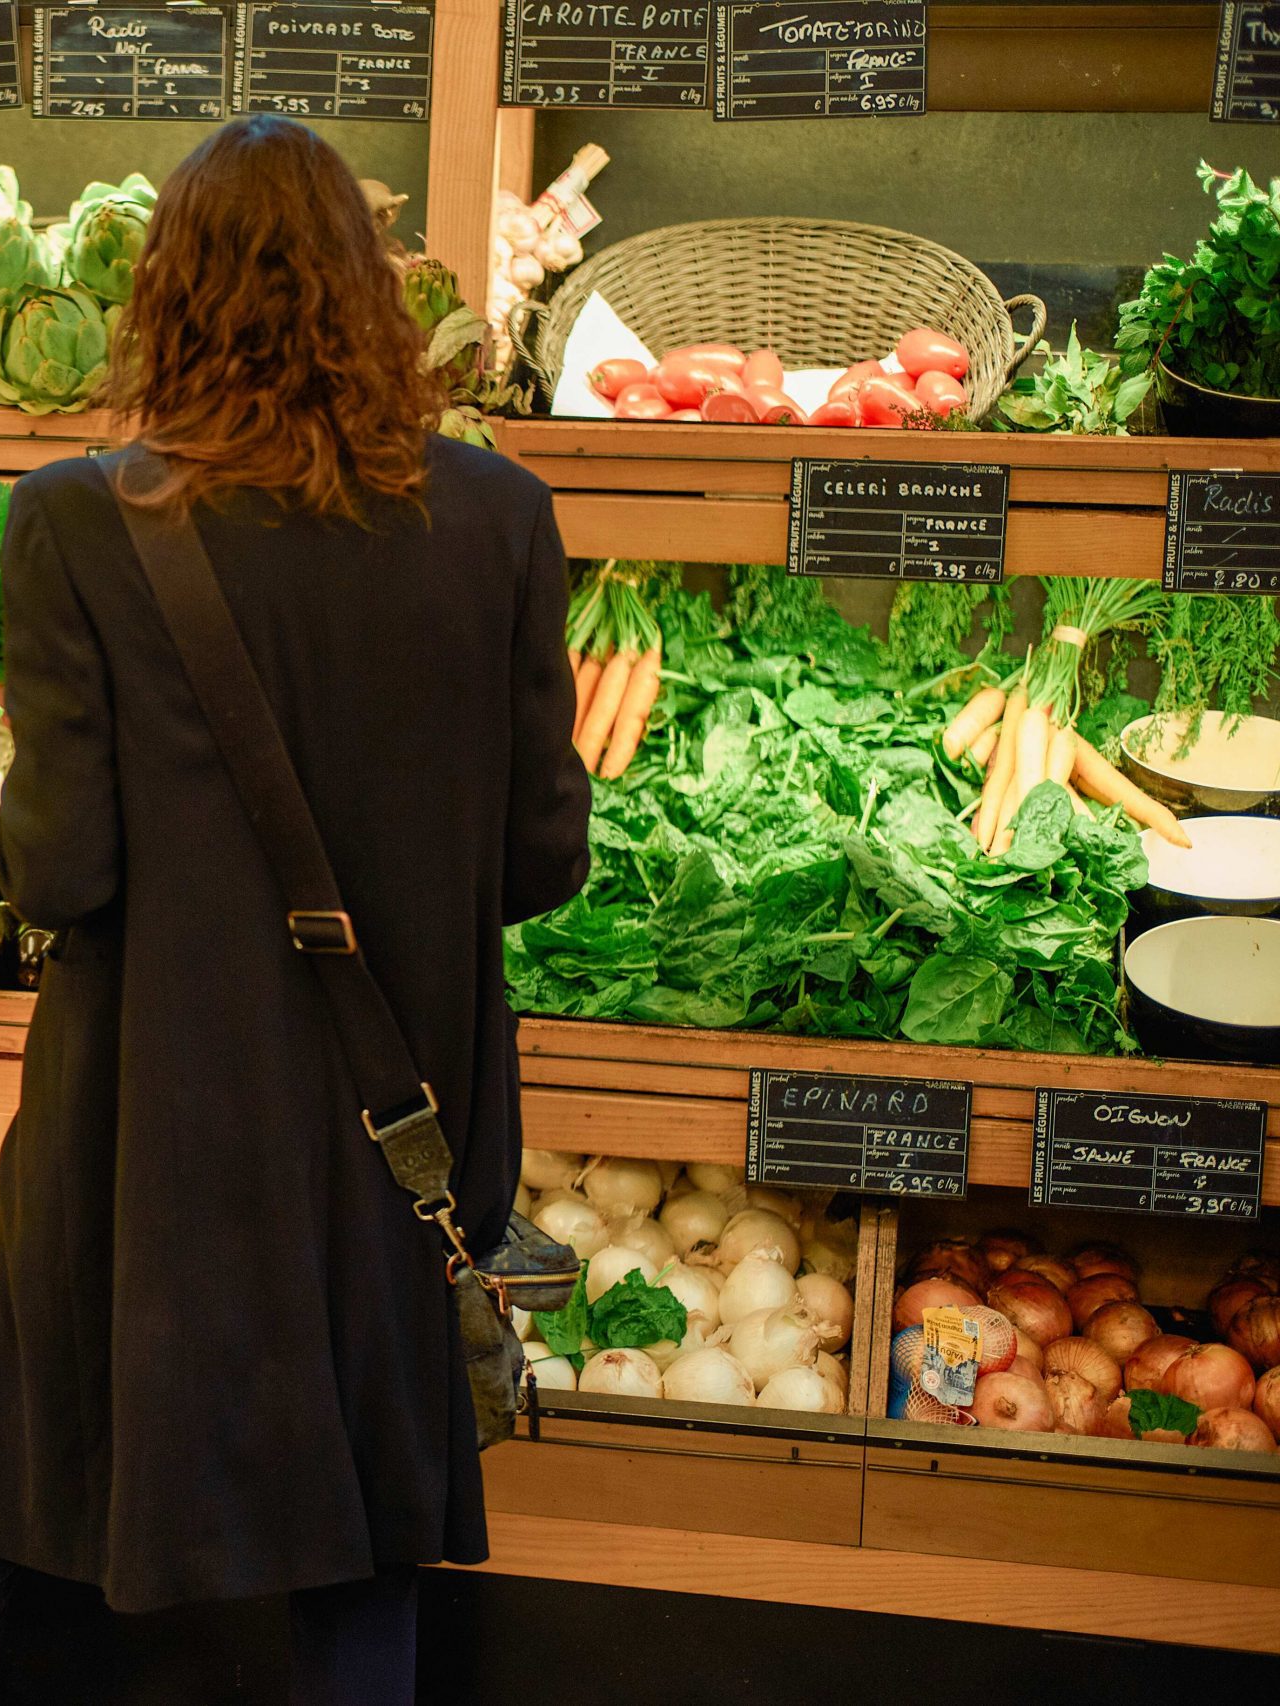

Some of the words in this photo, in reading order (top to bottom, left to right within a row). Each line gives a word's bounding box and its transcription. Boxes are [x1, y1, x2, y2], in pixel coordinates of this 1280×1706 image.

[234, 2, 247, 49] LÉGUMES
[642, 4, 708, 30] BOTTE
[1220, 2, 1235, 51] LÉGUMES
[87, 16, 148, 38] Radis
[371, 22, 416, 41] BOTTE
[714, 6, 726, 53] LÉGUMES
[624, 44, 707, 60] FRANCE
[717, 54, 726, 62] &
[846, 48, 916, 70] FRANCE
[1220, 53, 1228, 62] &
[358, 58, 412, 70] FRANCE
[504, 50, 514, 82] FRUITS
[641, 65, 665, 80] I
[232, 60, 244, 93] FRUITS
[717, 64, 726, 100] FRUITS
[859, 72, 877, 90] I
[1216, 64, 1227, 98] FRUITS
[502, 84, 512, 102] LES
[232, 95, 242, 112] LES
[716, 102, 725, 118] LES
[1213, 101, 1222, 118] LES
[792, 461, 803, 508] LÉGUMES
[898, 483, 982, 498] BRANCHE
[1167, 474, 1180, 522] LÉGUMES
[1204, 484, 1274, 514] Radis
[792, 510, 801, 518] &
[926, 518, 988, 531] FRANCE
[790, 519, 800, 555] FRUITS
[1167, 534, 1177, 569] FRUITS
[789, 555, 798, 572] LES
[974, 563, 997, 578] €/kg
[1165, 572, 1174, 588] LES
[749, 1071, 761, 1118] LÉGUMES
[750, 1118, 759, 1127] &
[1035, 1091, 1048, 1140] LÉGUMES
[1094, 1104, 1192, 1126] OIGNON
[748, 1128, 759, 1163] FRUITS
[873, 1130, 959, 1150] FRANCE
[1036, 1140, 1045, 1149] &
[897, 1152, 914, 1168] I
[1072, 1146, 1135, 1165] JAUNE
[1179, 1152, 1252, 1172] FRANCE
[748, 1164, 757, 1180] LES
[1034, 1150, 1044, 1186] FRUITS
[938, 1177, 960, 1193] €/kg
[1034, 1186, 1042, 1203] LES
[1230, 1197, 1253, 1214] €/kg
